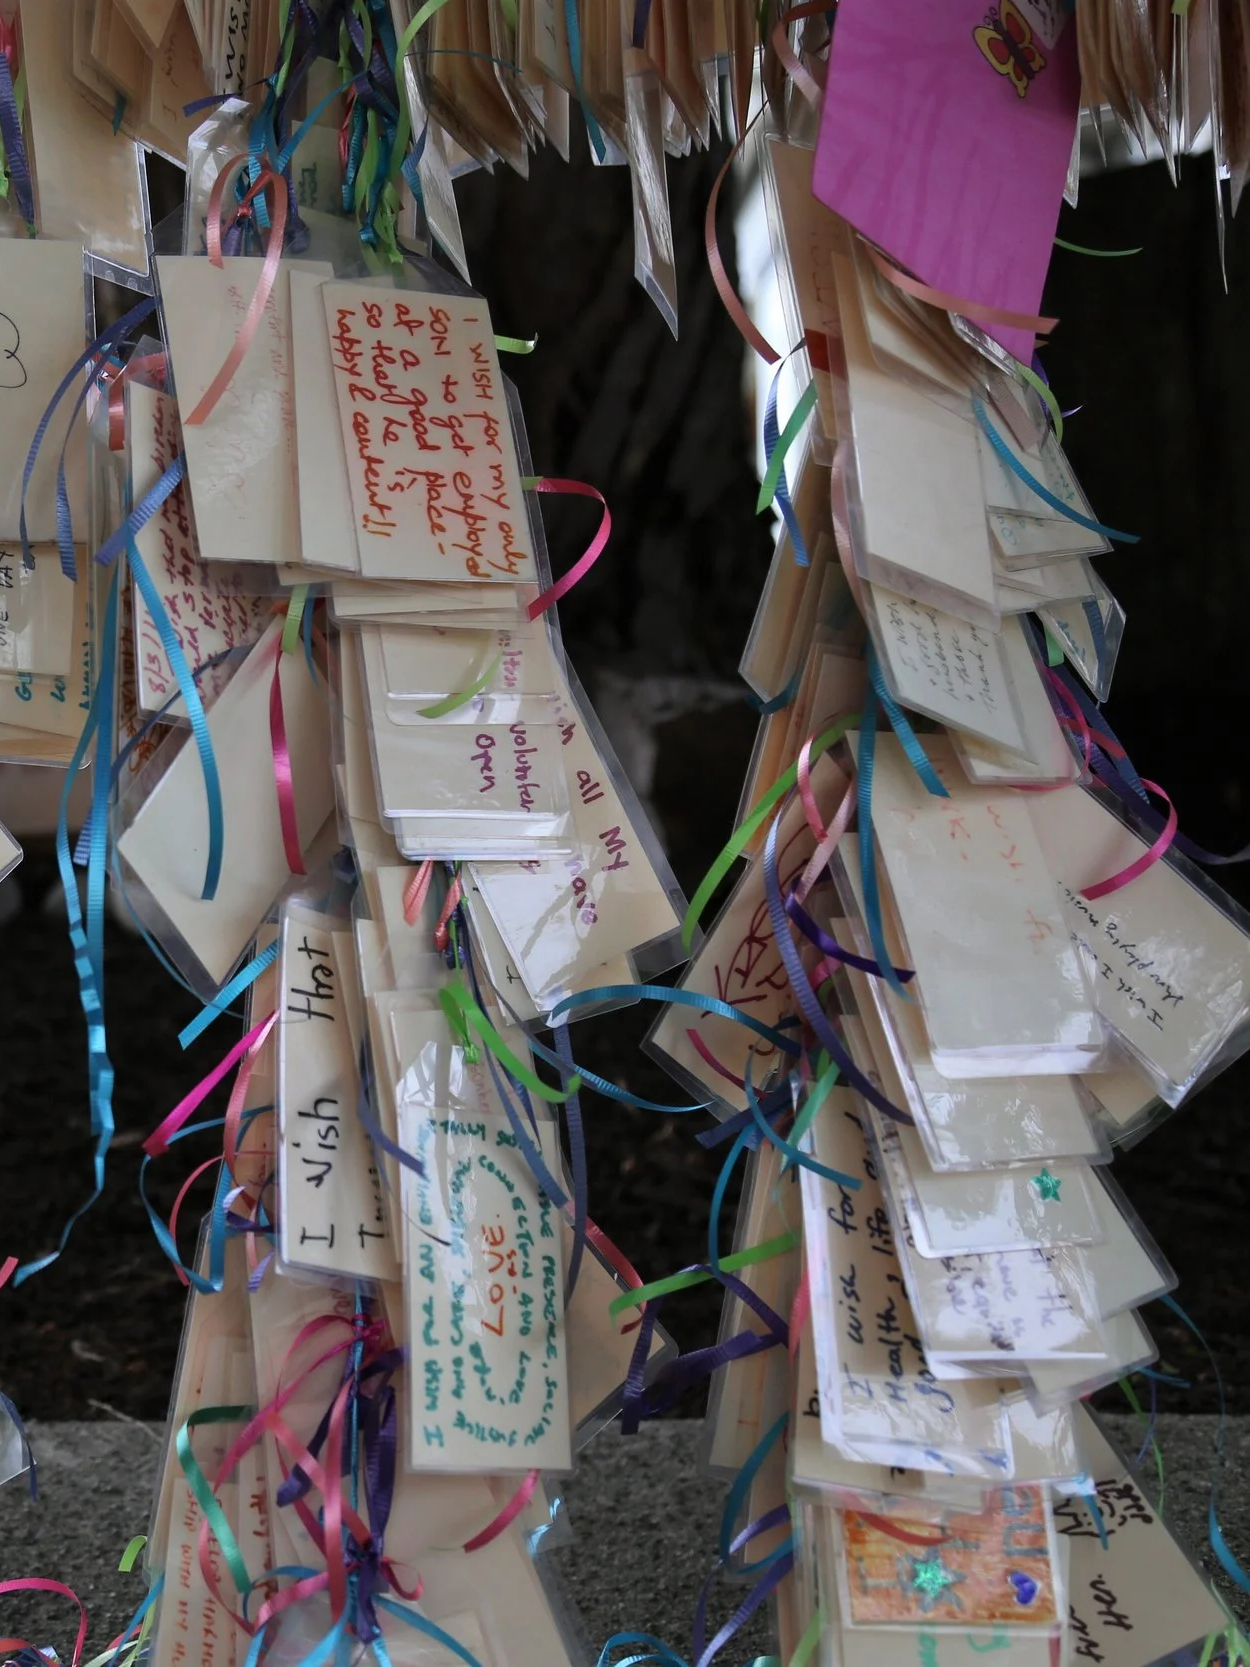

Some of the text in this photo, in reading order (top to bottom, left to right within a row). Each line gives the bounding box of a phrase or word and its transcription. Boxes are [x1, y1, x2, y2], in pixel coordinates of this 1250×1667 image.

[362, 301, 383, 329] so
[333, 308, 363, 378] happy
[400, 350, 421, 372] a
[441, 374, 458, 404] to
[481, 464, 511, 510] my
[487, 521, 528, 576] only
[576, 768, 605, 805] all
[299, 1223, 336, 1249] I
[419, 1243, 437, 1285] AN
[837, 1263, 865, 1345] wish
[422, 1424, 445, 1448] I
